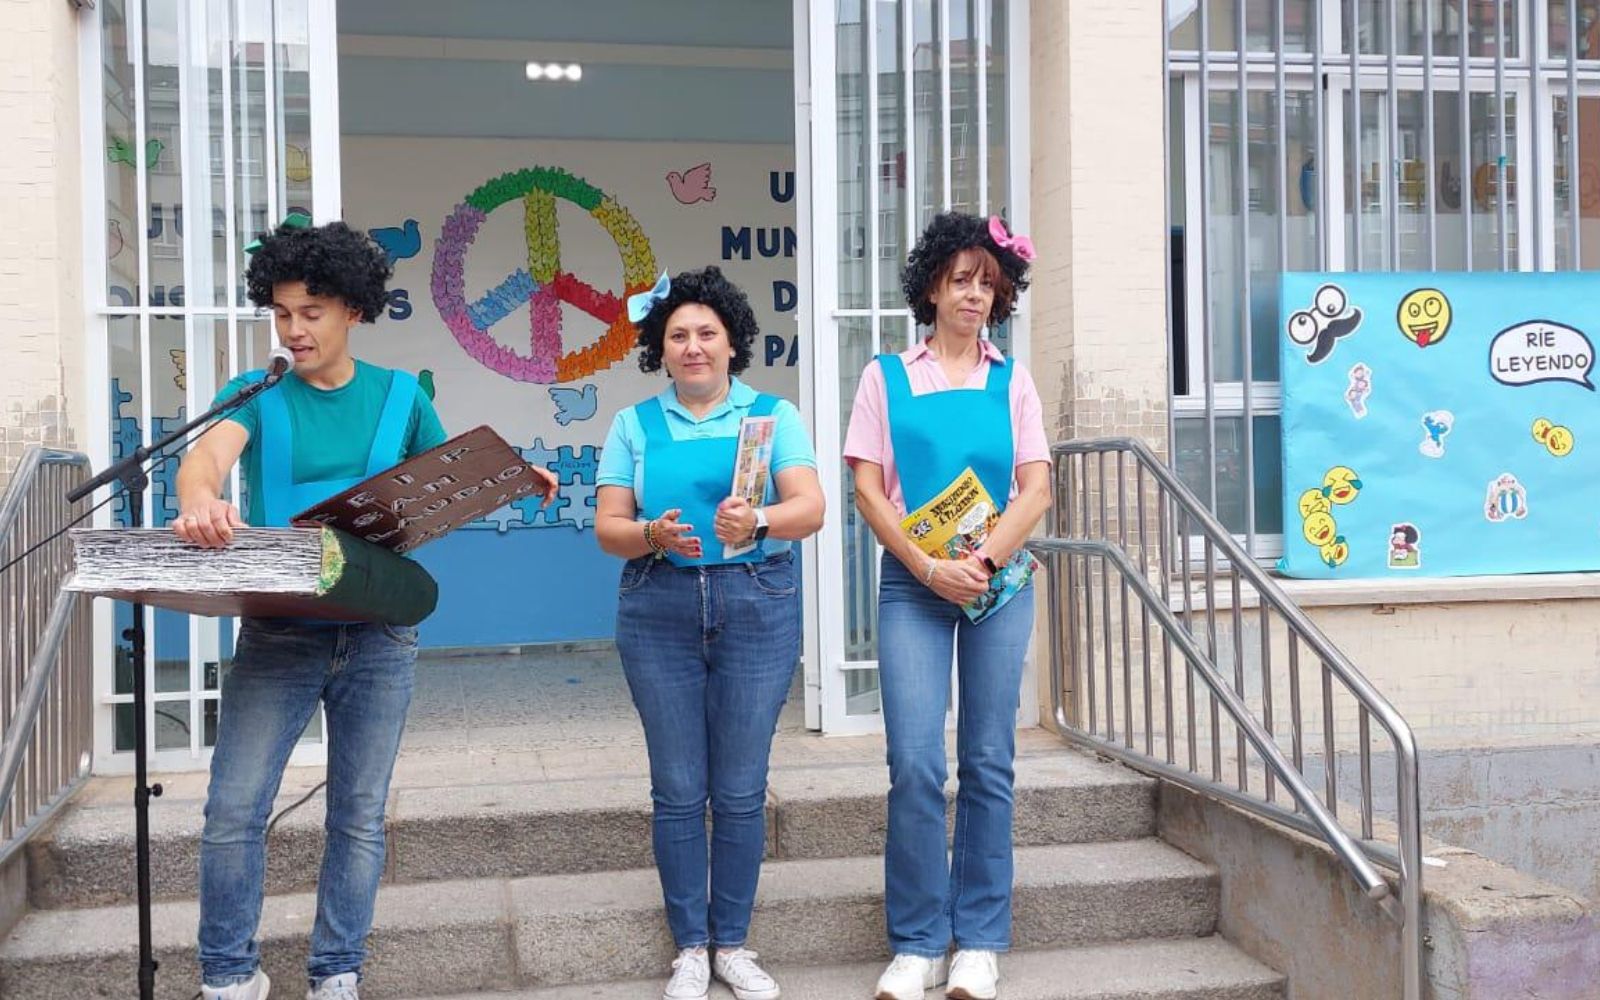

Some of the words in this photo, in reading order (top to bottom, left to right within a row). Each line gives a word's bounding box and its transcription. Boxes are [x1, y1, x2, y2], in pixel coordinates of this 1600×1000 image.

[770, 171, 795, 203] U
[721, 226, 798, 260] MUN
[773, 281, 798, 312] D
[764, 335, 798, 366] PA
[1526, 328, 1556, 347] RÍE
[1497, 354, 1588, 372] LEYENDO
[364, 465, 527, 542] LAUDIO
